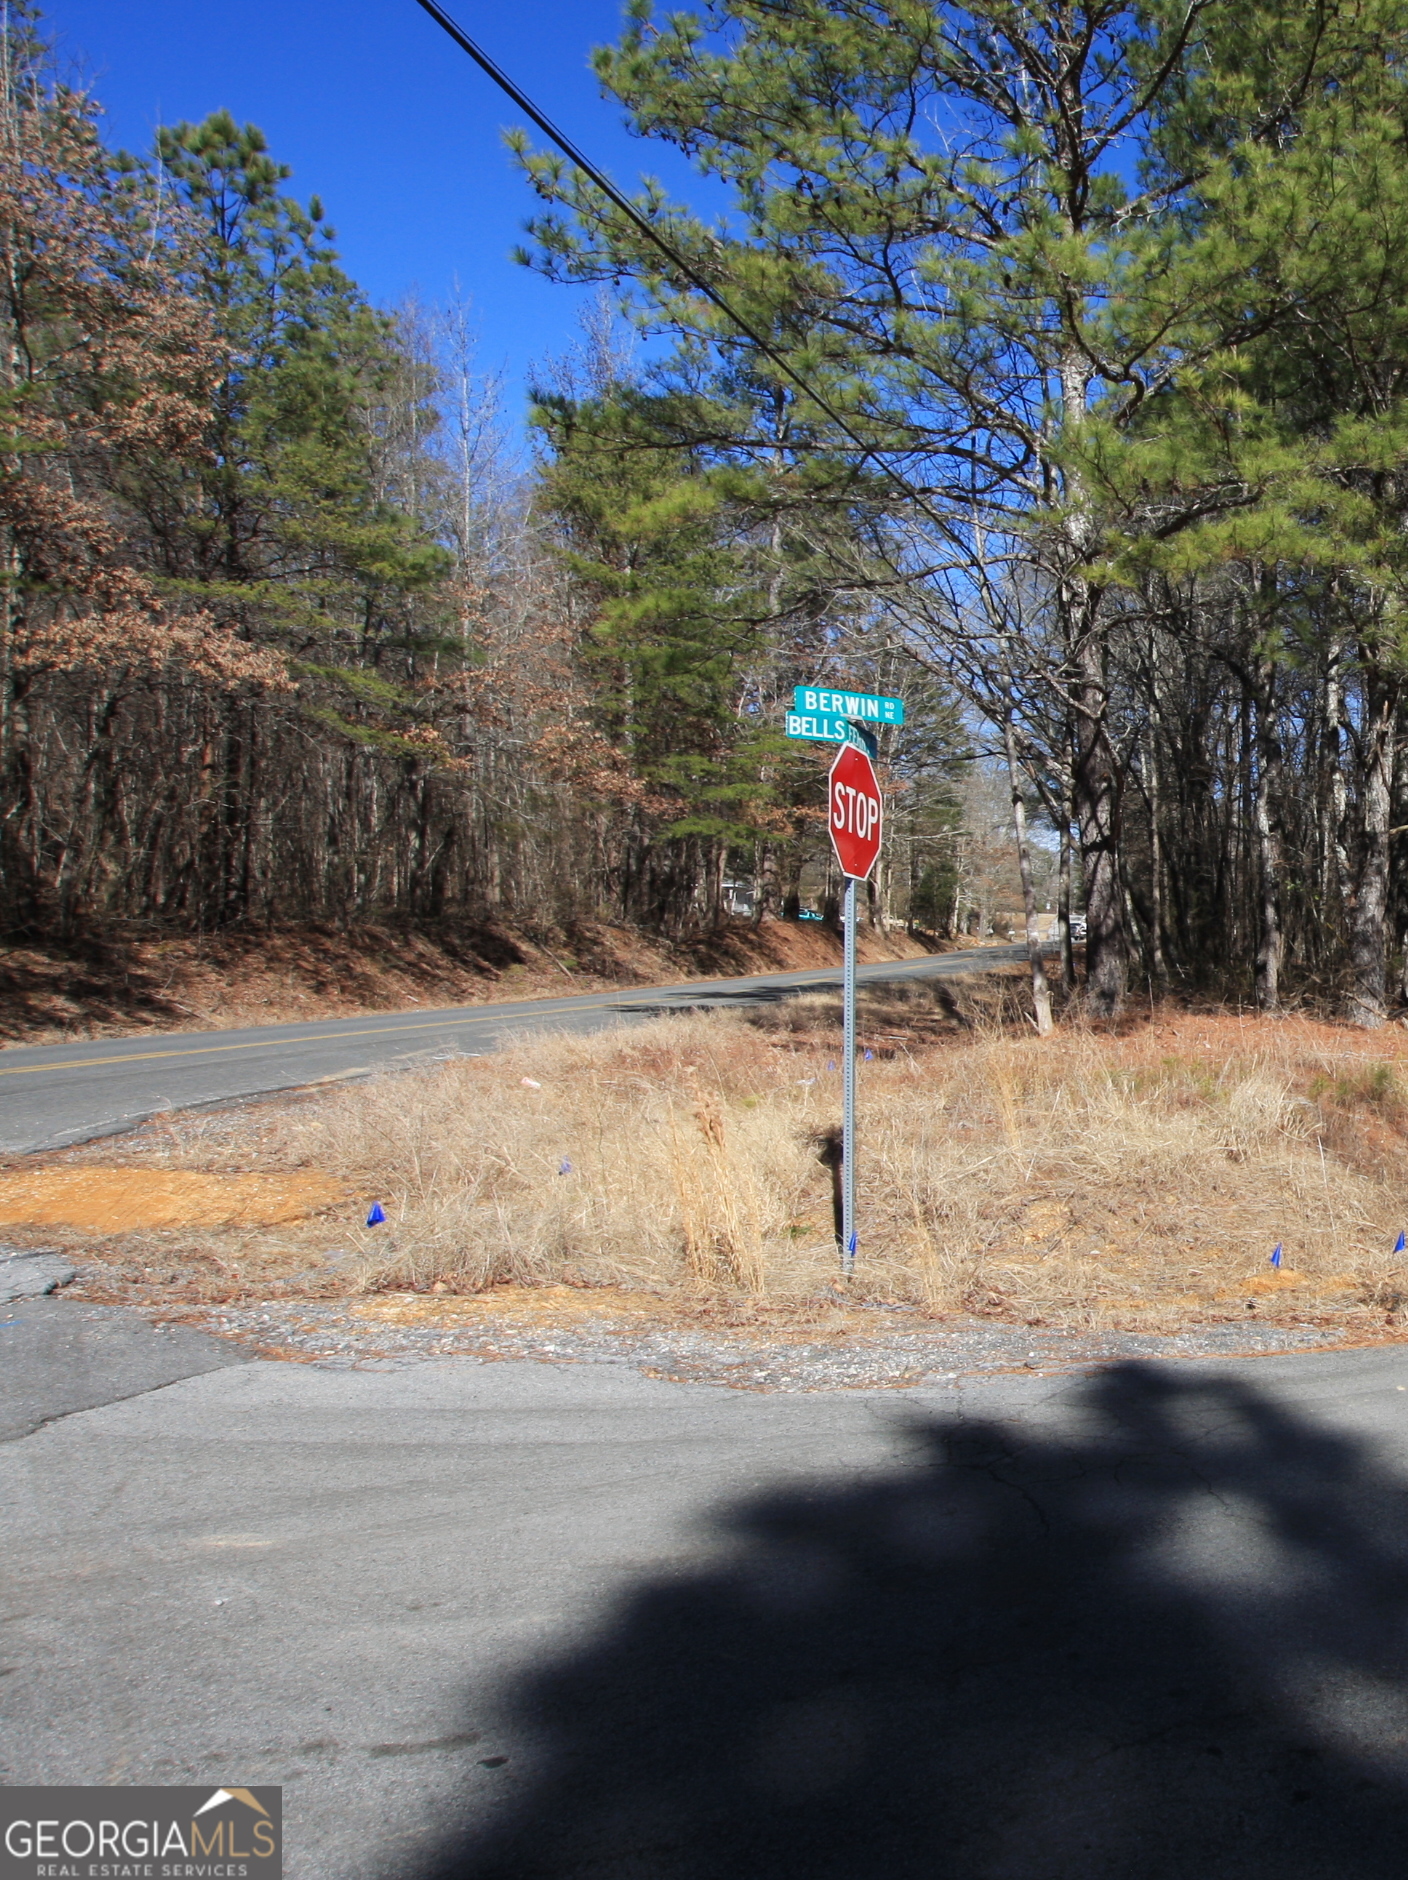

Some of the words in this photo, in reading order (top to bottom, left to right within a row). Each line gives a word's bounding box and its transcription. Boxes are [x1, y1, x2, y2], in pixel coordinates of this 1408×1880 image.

[804, 690, 879, 719] BERWIN
[884, 701, 895, 710] RD
[884, 711, 895, 720] NE
[789, 715, 846, 740] BELLS
[833, 781, 879, 842] STOP
